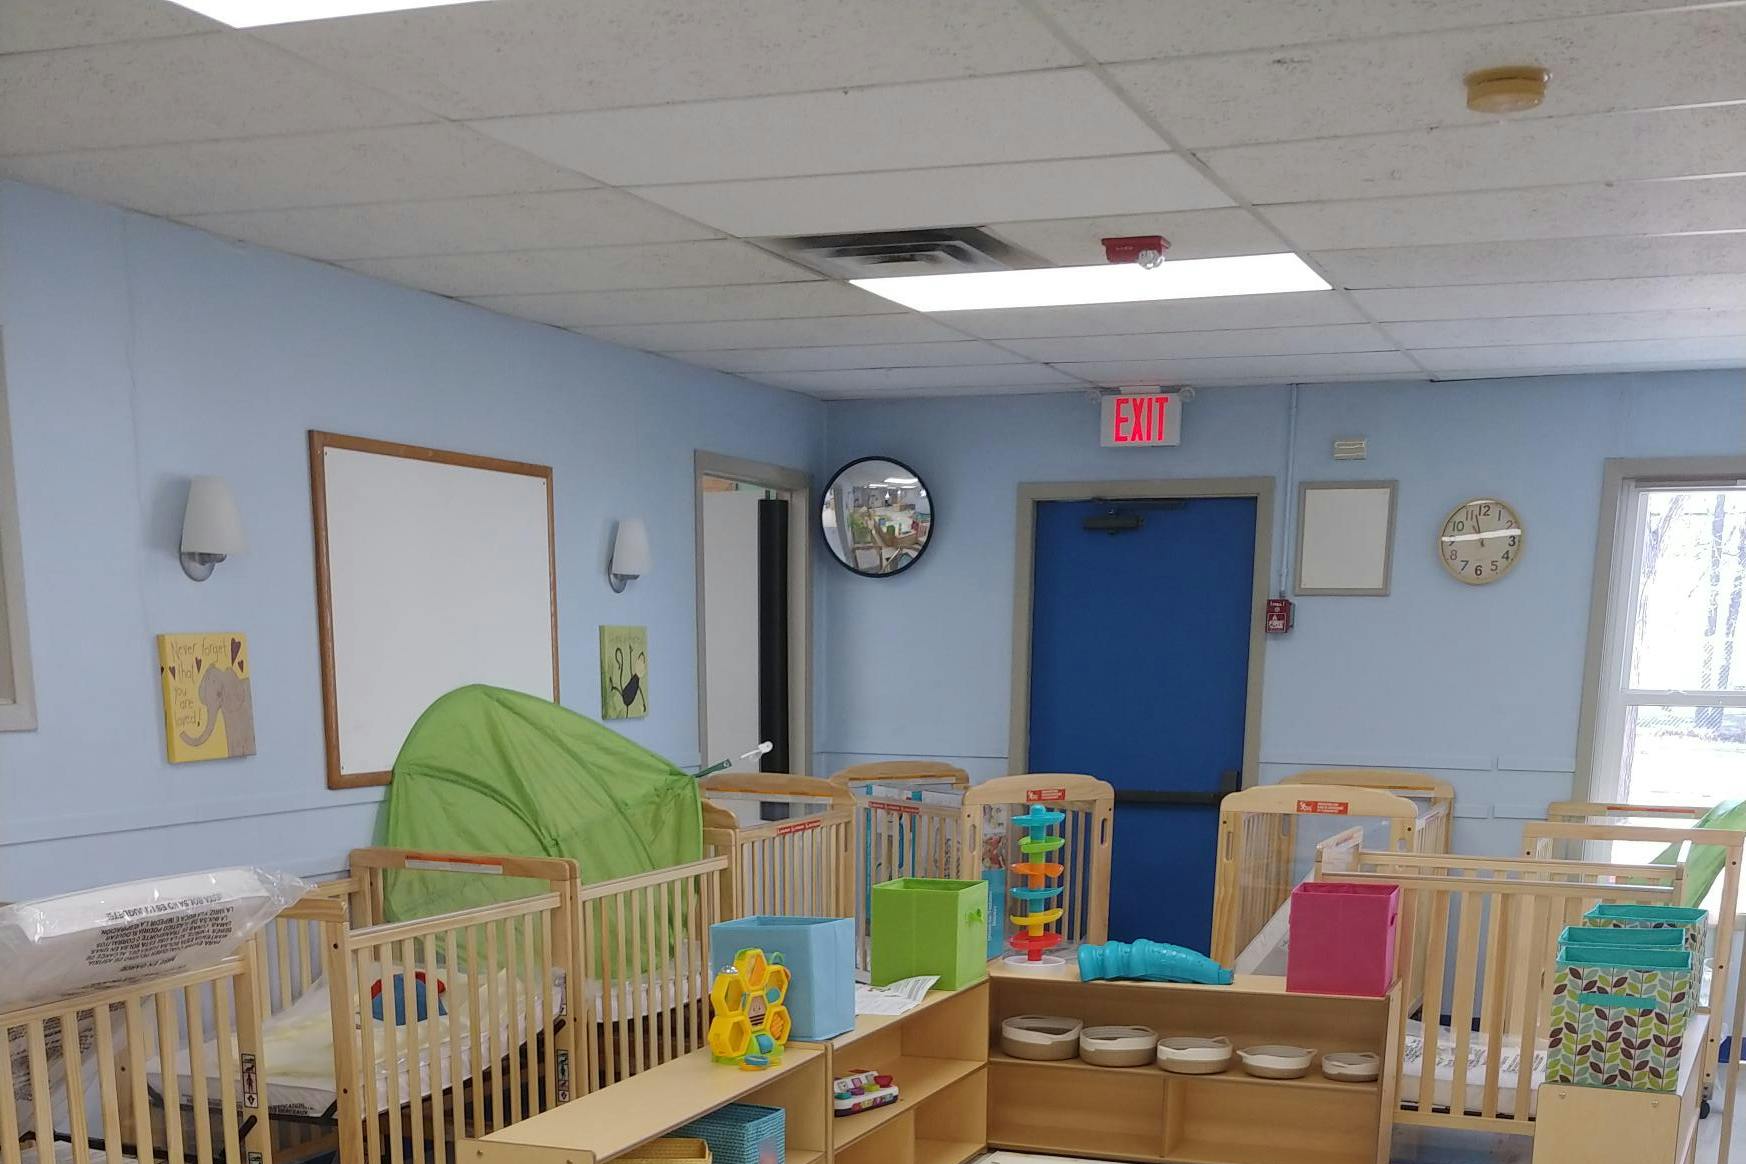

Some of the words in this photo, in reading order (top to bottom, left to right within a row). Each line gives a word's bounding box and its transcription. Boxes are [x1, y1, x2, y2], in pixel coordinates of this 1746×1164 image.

[1115, 397, 1168, 441] EXIT
[1466, 510, 1473, 521] 11
[1478, 505, 1491, 516] 12
[1498, 510, 1502, 521] 1
[1452, 521, 1464, 531] 10
[1508, 536, 1515, 546] 3
[1450, 550, 1457, 560] 8
[1501, 550, 1509, 560] 4
[1461, 560, 1469, 571] 7
[1475, 565, 1482, 576] 6
[1490, 560, 1498, 571] 5
[202, 637, 228, 662] forget
